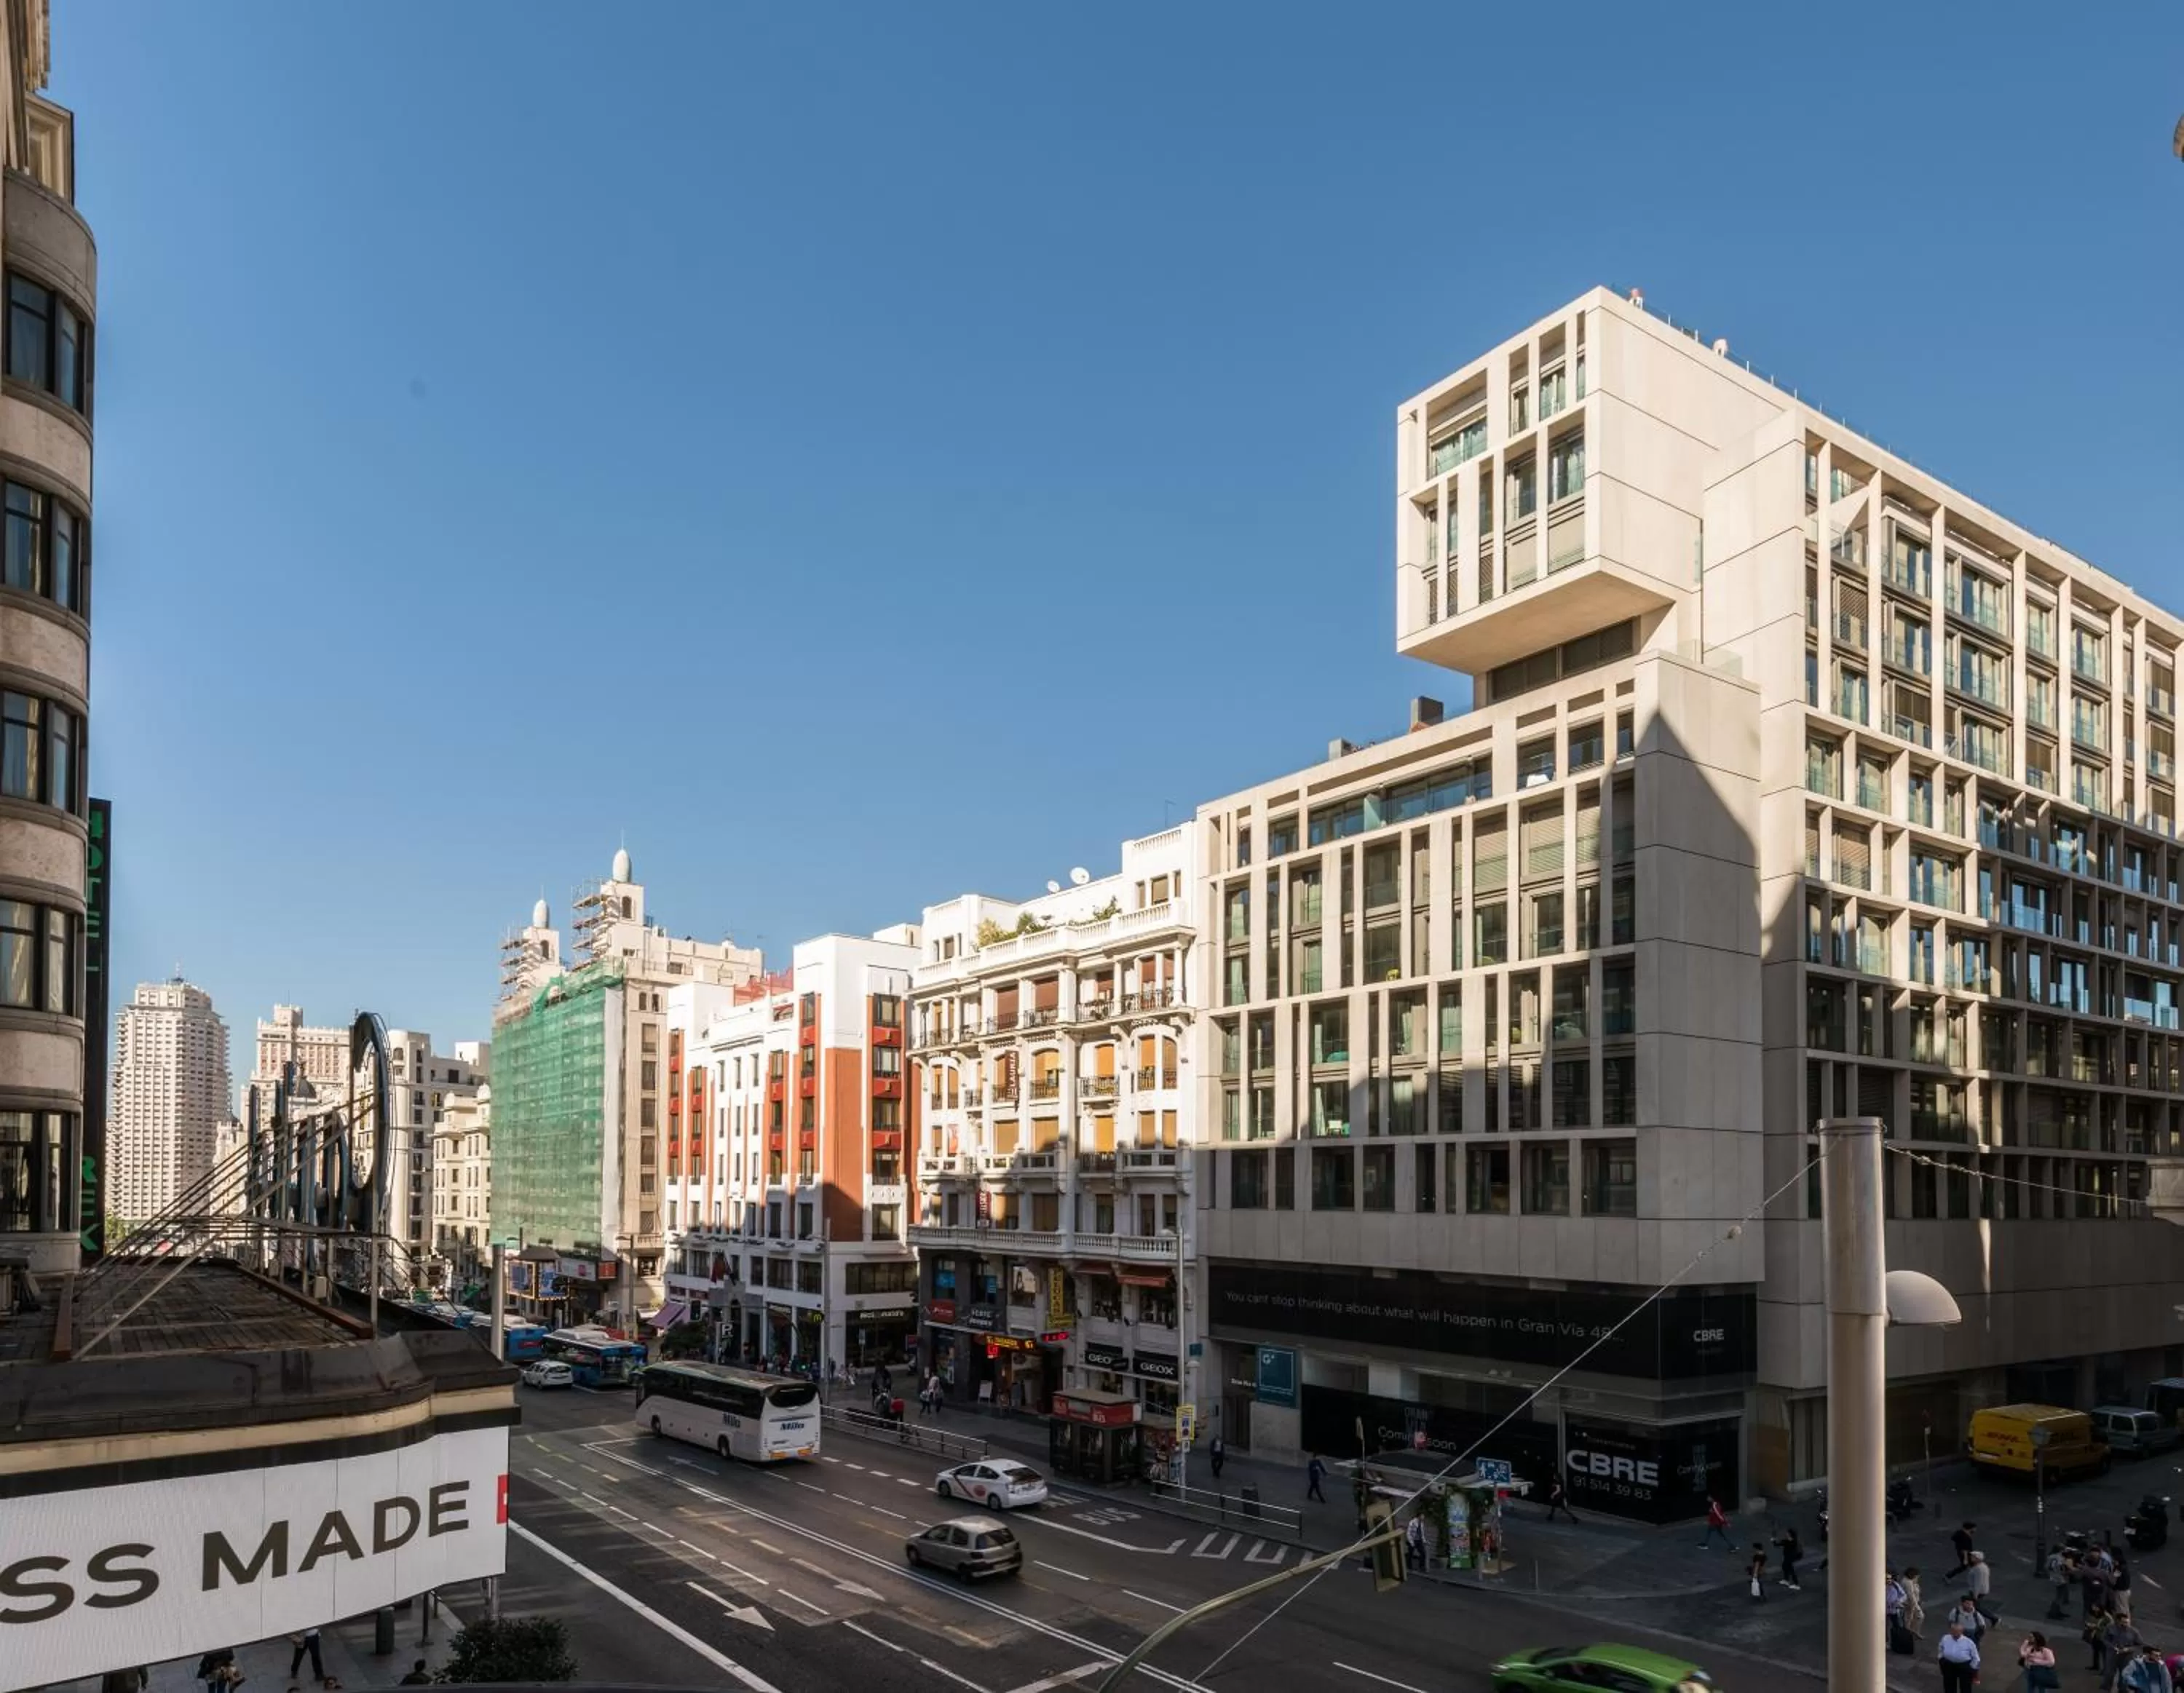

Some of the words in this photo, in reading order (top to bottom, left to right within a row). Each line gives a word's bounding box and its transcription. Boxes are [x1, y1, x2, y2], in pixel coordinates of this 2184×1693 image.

[1345, 1302, 1380, 1316] about
[1384, 1305, 1413, 1319] what
[1419, 1309, 1439, 1322] will
[1444, 1312, 1497, 1328] happen
[1500, 1317, 1514, 1329] in
[1518, 1317, 1554, 1334] Gran
[1693, 1328, 1725, 1342] CBRE
[1139, 1362, 1174, 1375] GEOX
[1567, 1449, 1659, 1488] CBRE
[202, 1480, 470, 1592] MADE
